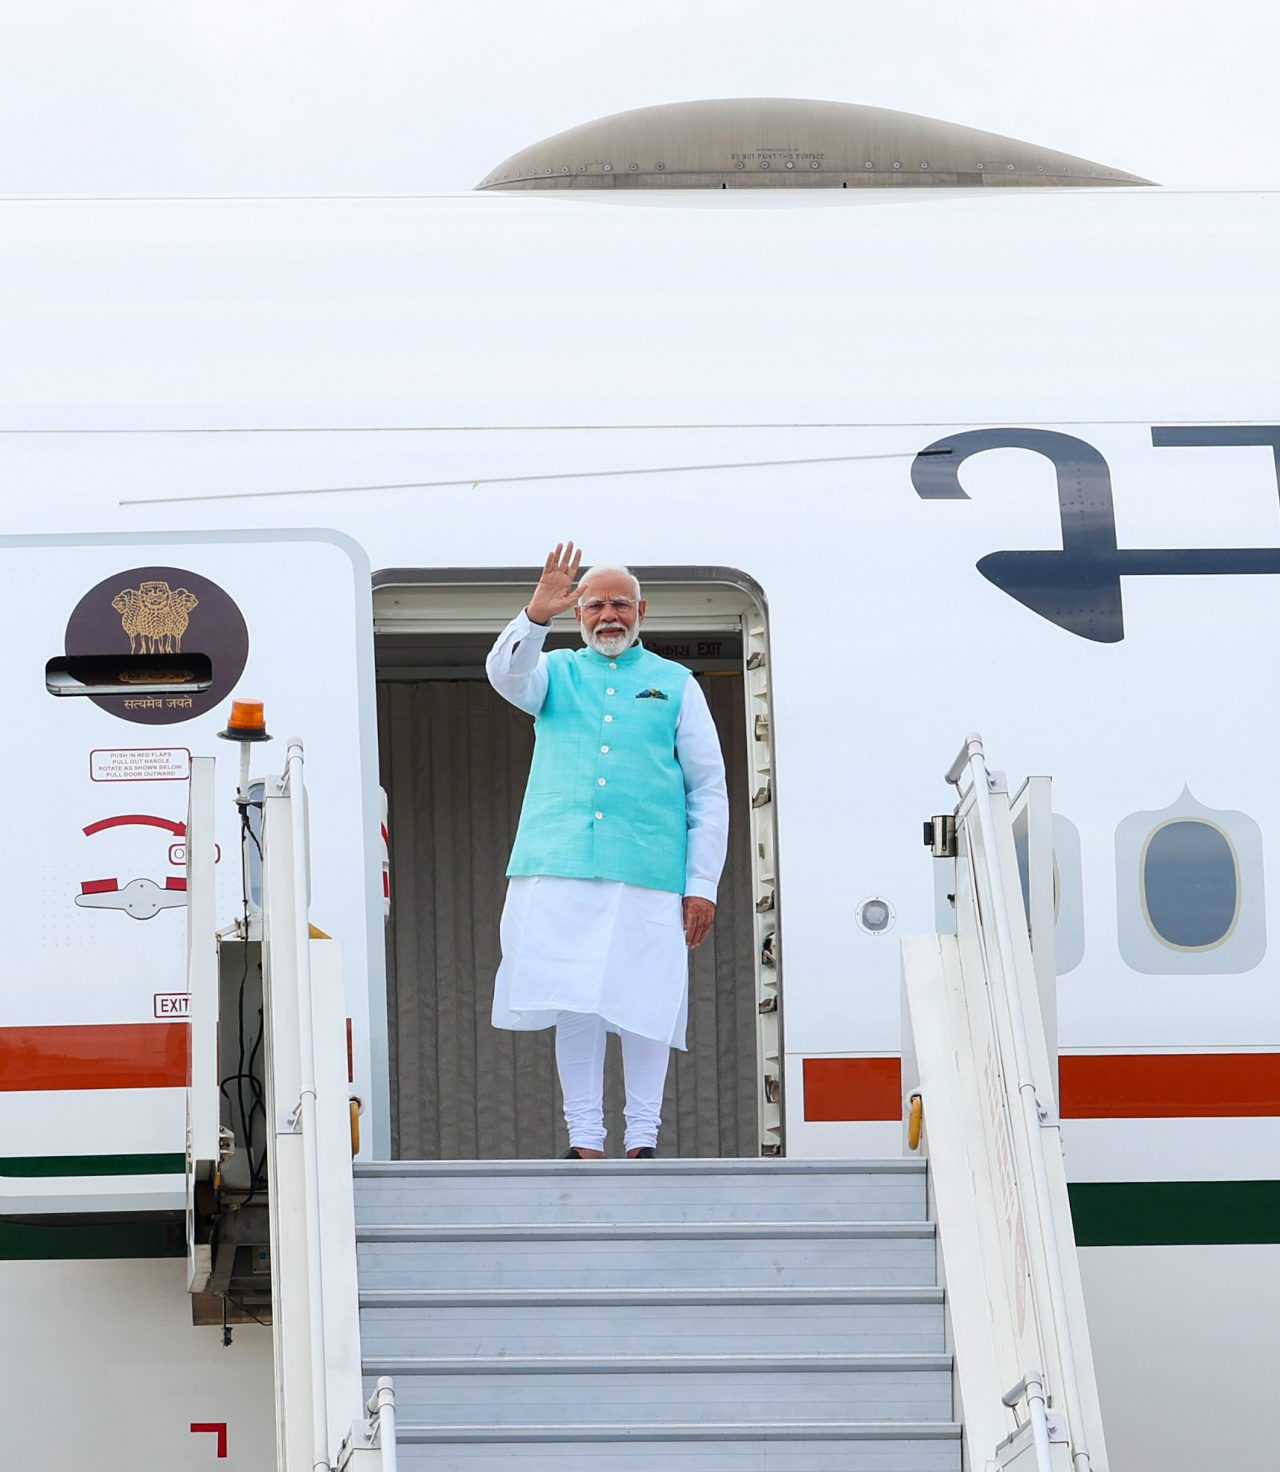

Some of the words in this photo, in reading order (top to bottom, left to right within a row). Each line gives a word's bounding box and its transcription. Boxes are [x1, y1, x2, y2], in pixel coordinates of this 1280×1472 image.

[698, 642, 722, 656] EXIT
[124, 696, 162, 709] सत्यमेव
[166, 695, 192, 708] जयते
[161, 998, 189, 1012] EXIT
